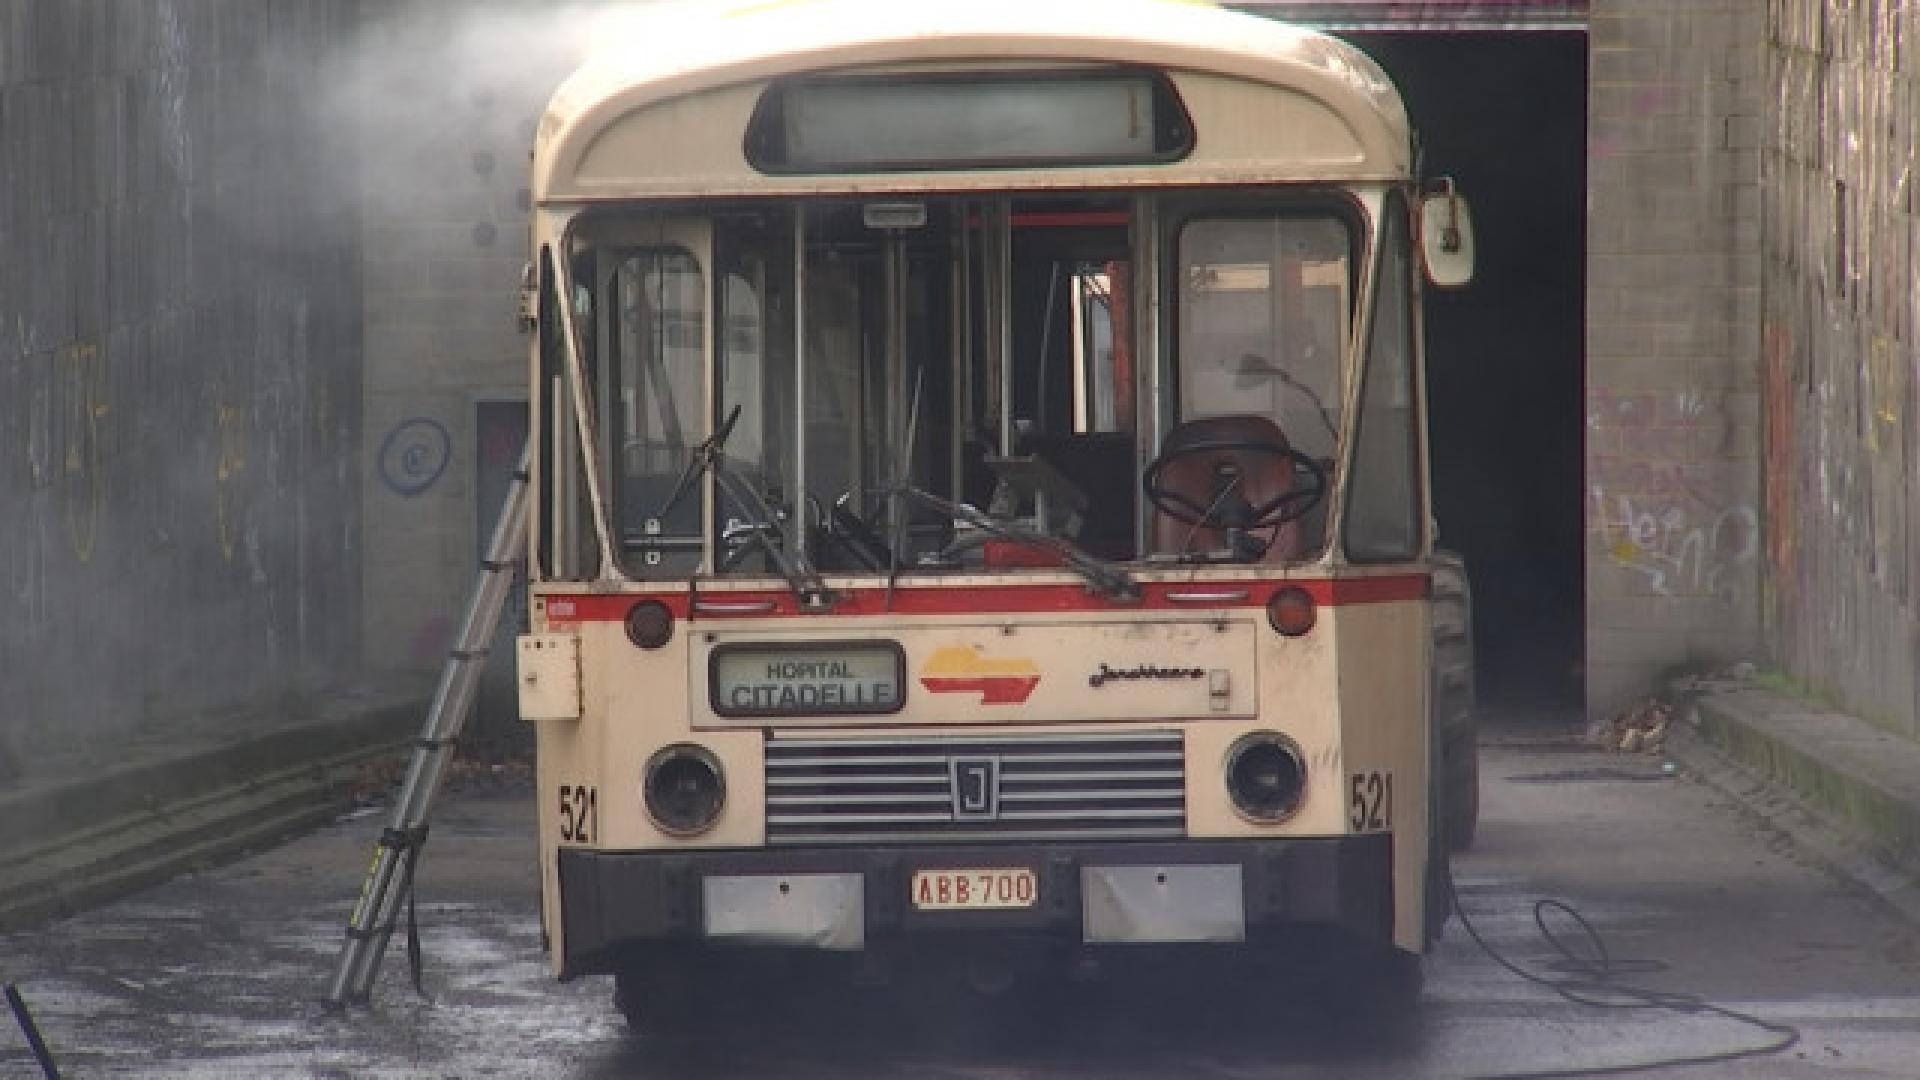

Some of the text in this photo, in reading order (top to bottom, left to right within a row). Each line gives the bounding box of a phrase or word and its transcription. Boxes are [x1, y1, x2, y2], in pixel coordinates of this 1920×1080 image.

[731, 683, 890, 709] CITADELLE
[560, 785, 597, 844] 521
[1352, 771, 1393, 831] 521
